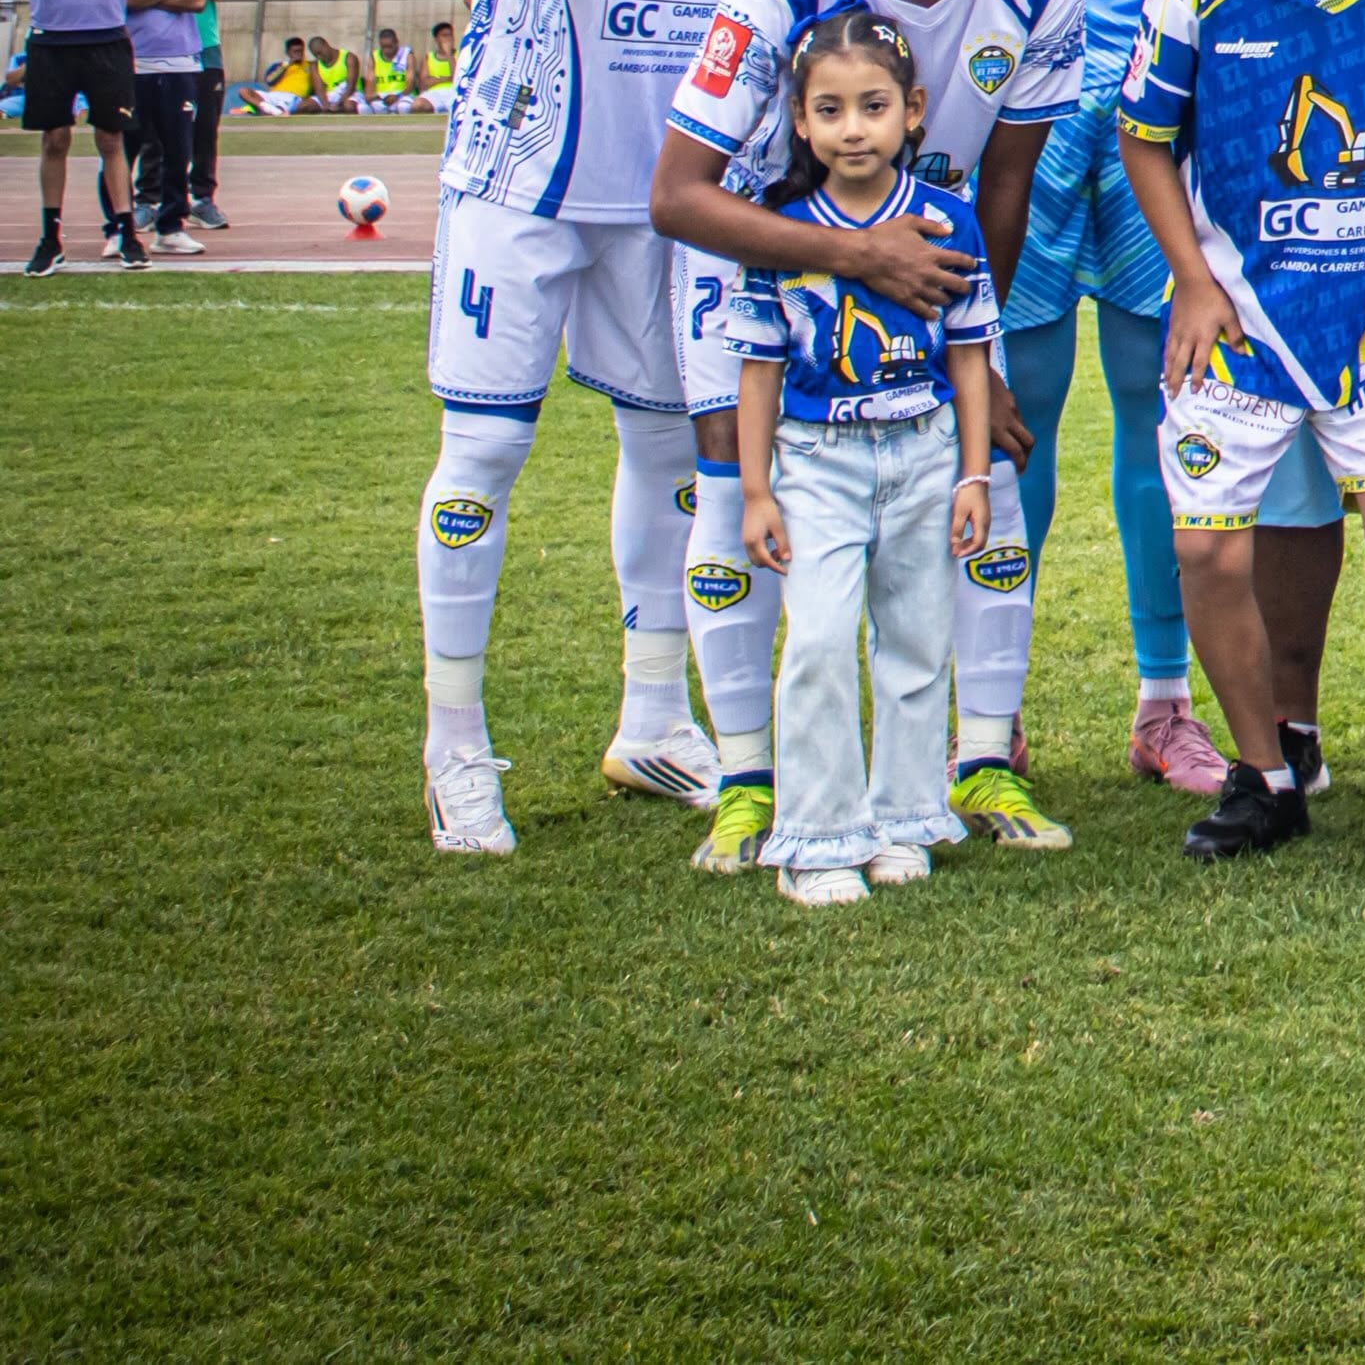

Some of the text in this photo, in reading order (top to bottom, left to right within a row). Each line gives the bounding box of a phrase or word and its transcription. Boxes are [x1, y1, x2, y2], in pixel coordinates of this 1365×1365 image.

[608, 1, 660, 38] GC
[672, 5, 717, 19] GAMBO
[668, 29, 706, 43] CARRE
[1264, 202, 1321, 237] GC
[460, 268, 495, 340] 4
[885, 382, 930, 402] GAMBOA
[835, 397, 874, 422] GC
